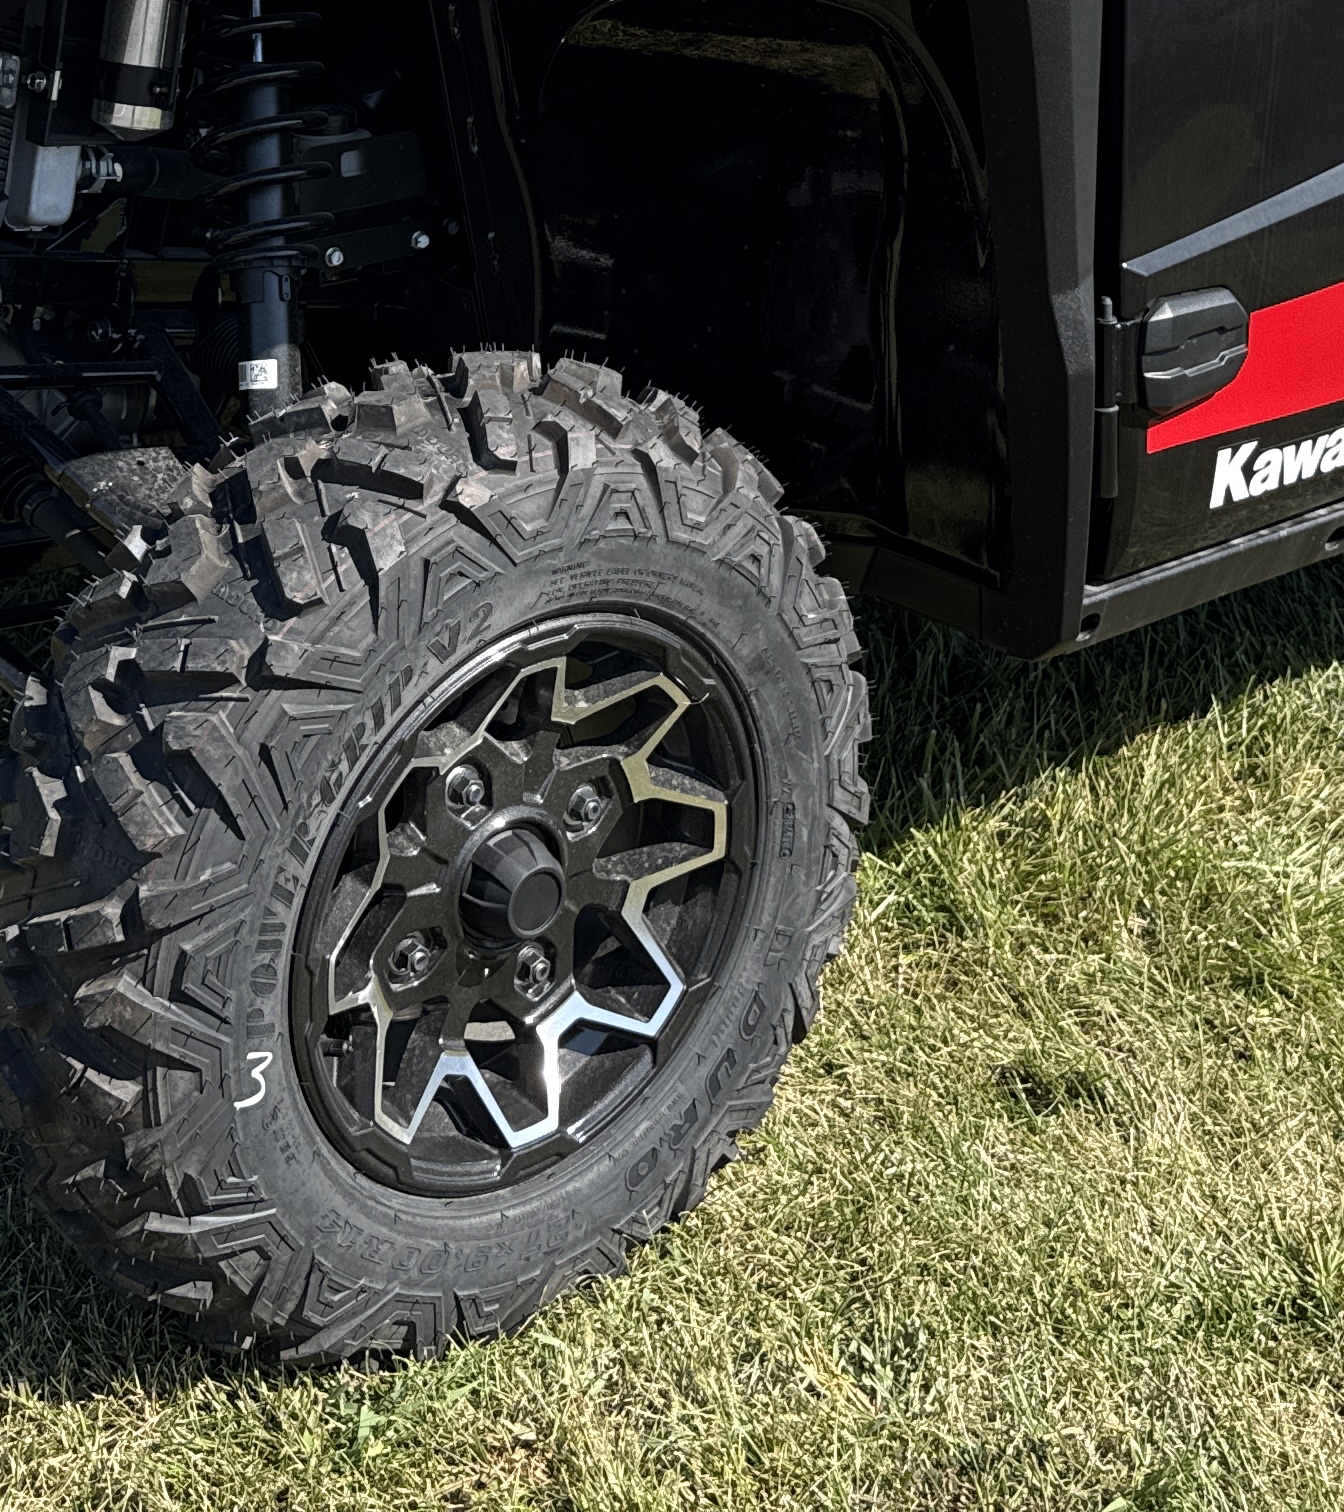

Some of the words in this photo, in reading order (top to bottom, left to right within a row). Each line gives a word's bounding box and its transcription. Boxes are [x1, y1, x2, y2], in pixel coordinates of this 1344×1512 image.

[428, 600, 494, 665] V2
[233, 1051, 273, 1111] 3
[624, 990, 767, 1192] DURO
